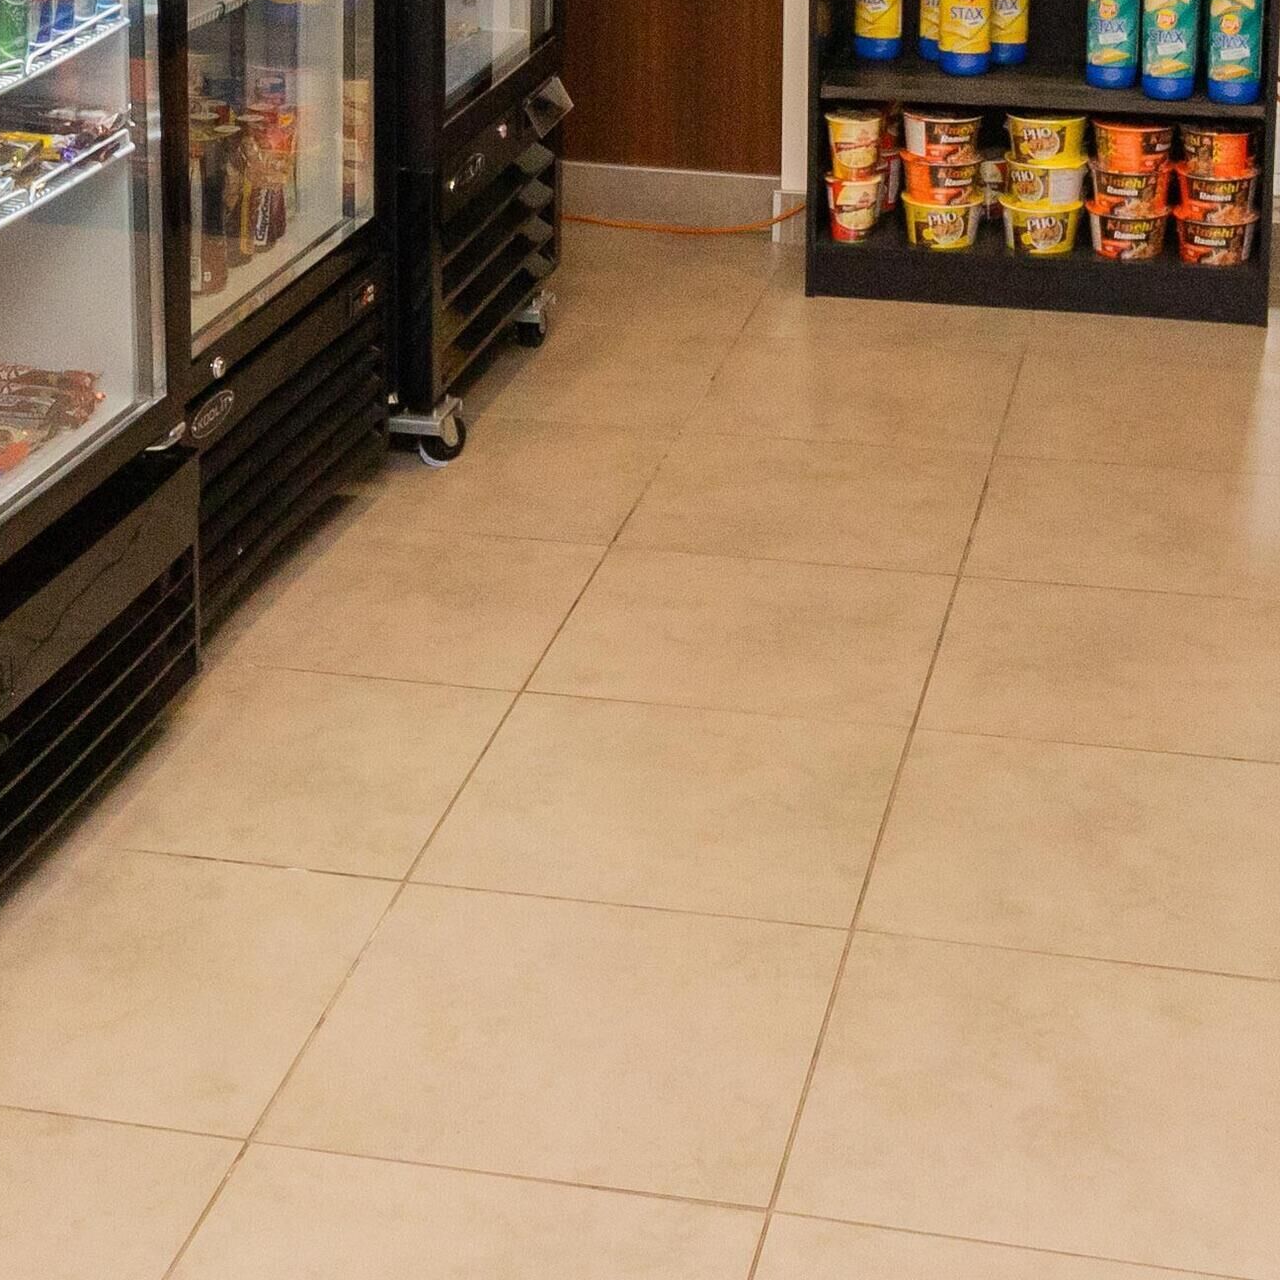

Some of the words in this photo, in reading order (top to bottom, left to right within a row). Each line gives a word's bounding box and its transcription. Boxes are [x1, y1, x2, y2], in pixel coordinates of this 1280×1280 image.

[950, 7, 985, 20] STAX
[1149, 30, 1184, 43] STAX
[1022, 128, 1051, 141] PHO
[1011, 170, 1034, 183] PHO
[1101, 174, 1147, 189] Kimchi
[1107, 186, 1138, 196] Ramen
[1193, 180, 1240, 194] Kimchi
[1199, 192, 1232, 202] Ramen
[927, 212, 957, 227] PHO
[1026, 216, 1056, 231] PHO
[1107, 220, 1154, 232] Kimchi
[1114, 231, 1146, 240] Ramen
[1188, 225, 1235, 239] Kimchi
[1194, 236, 1227, 246] Ramen
